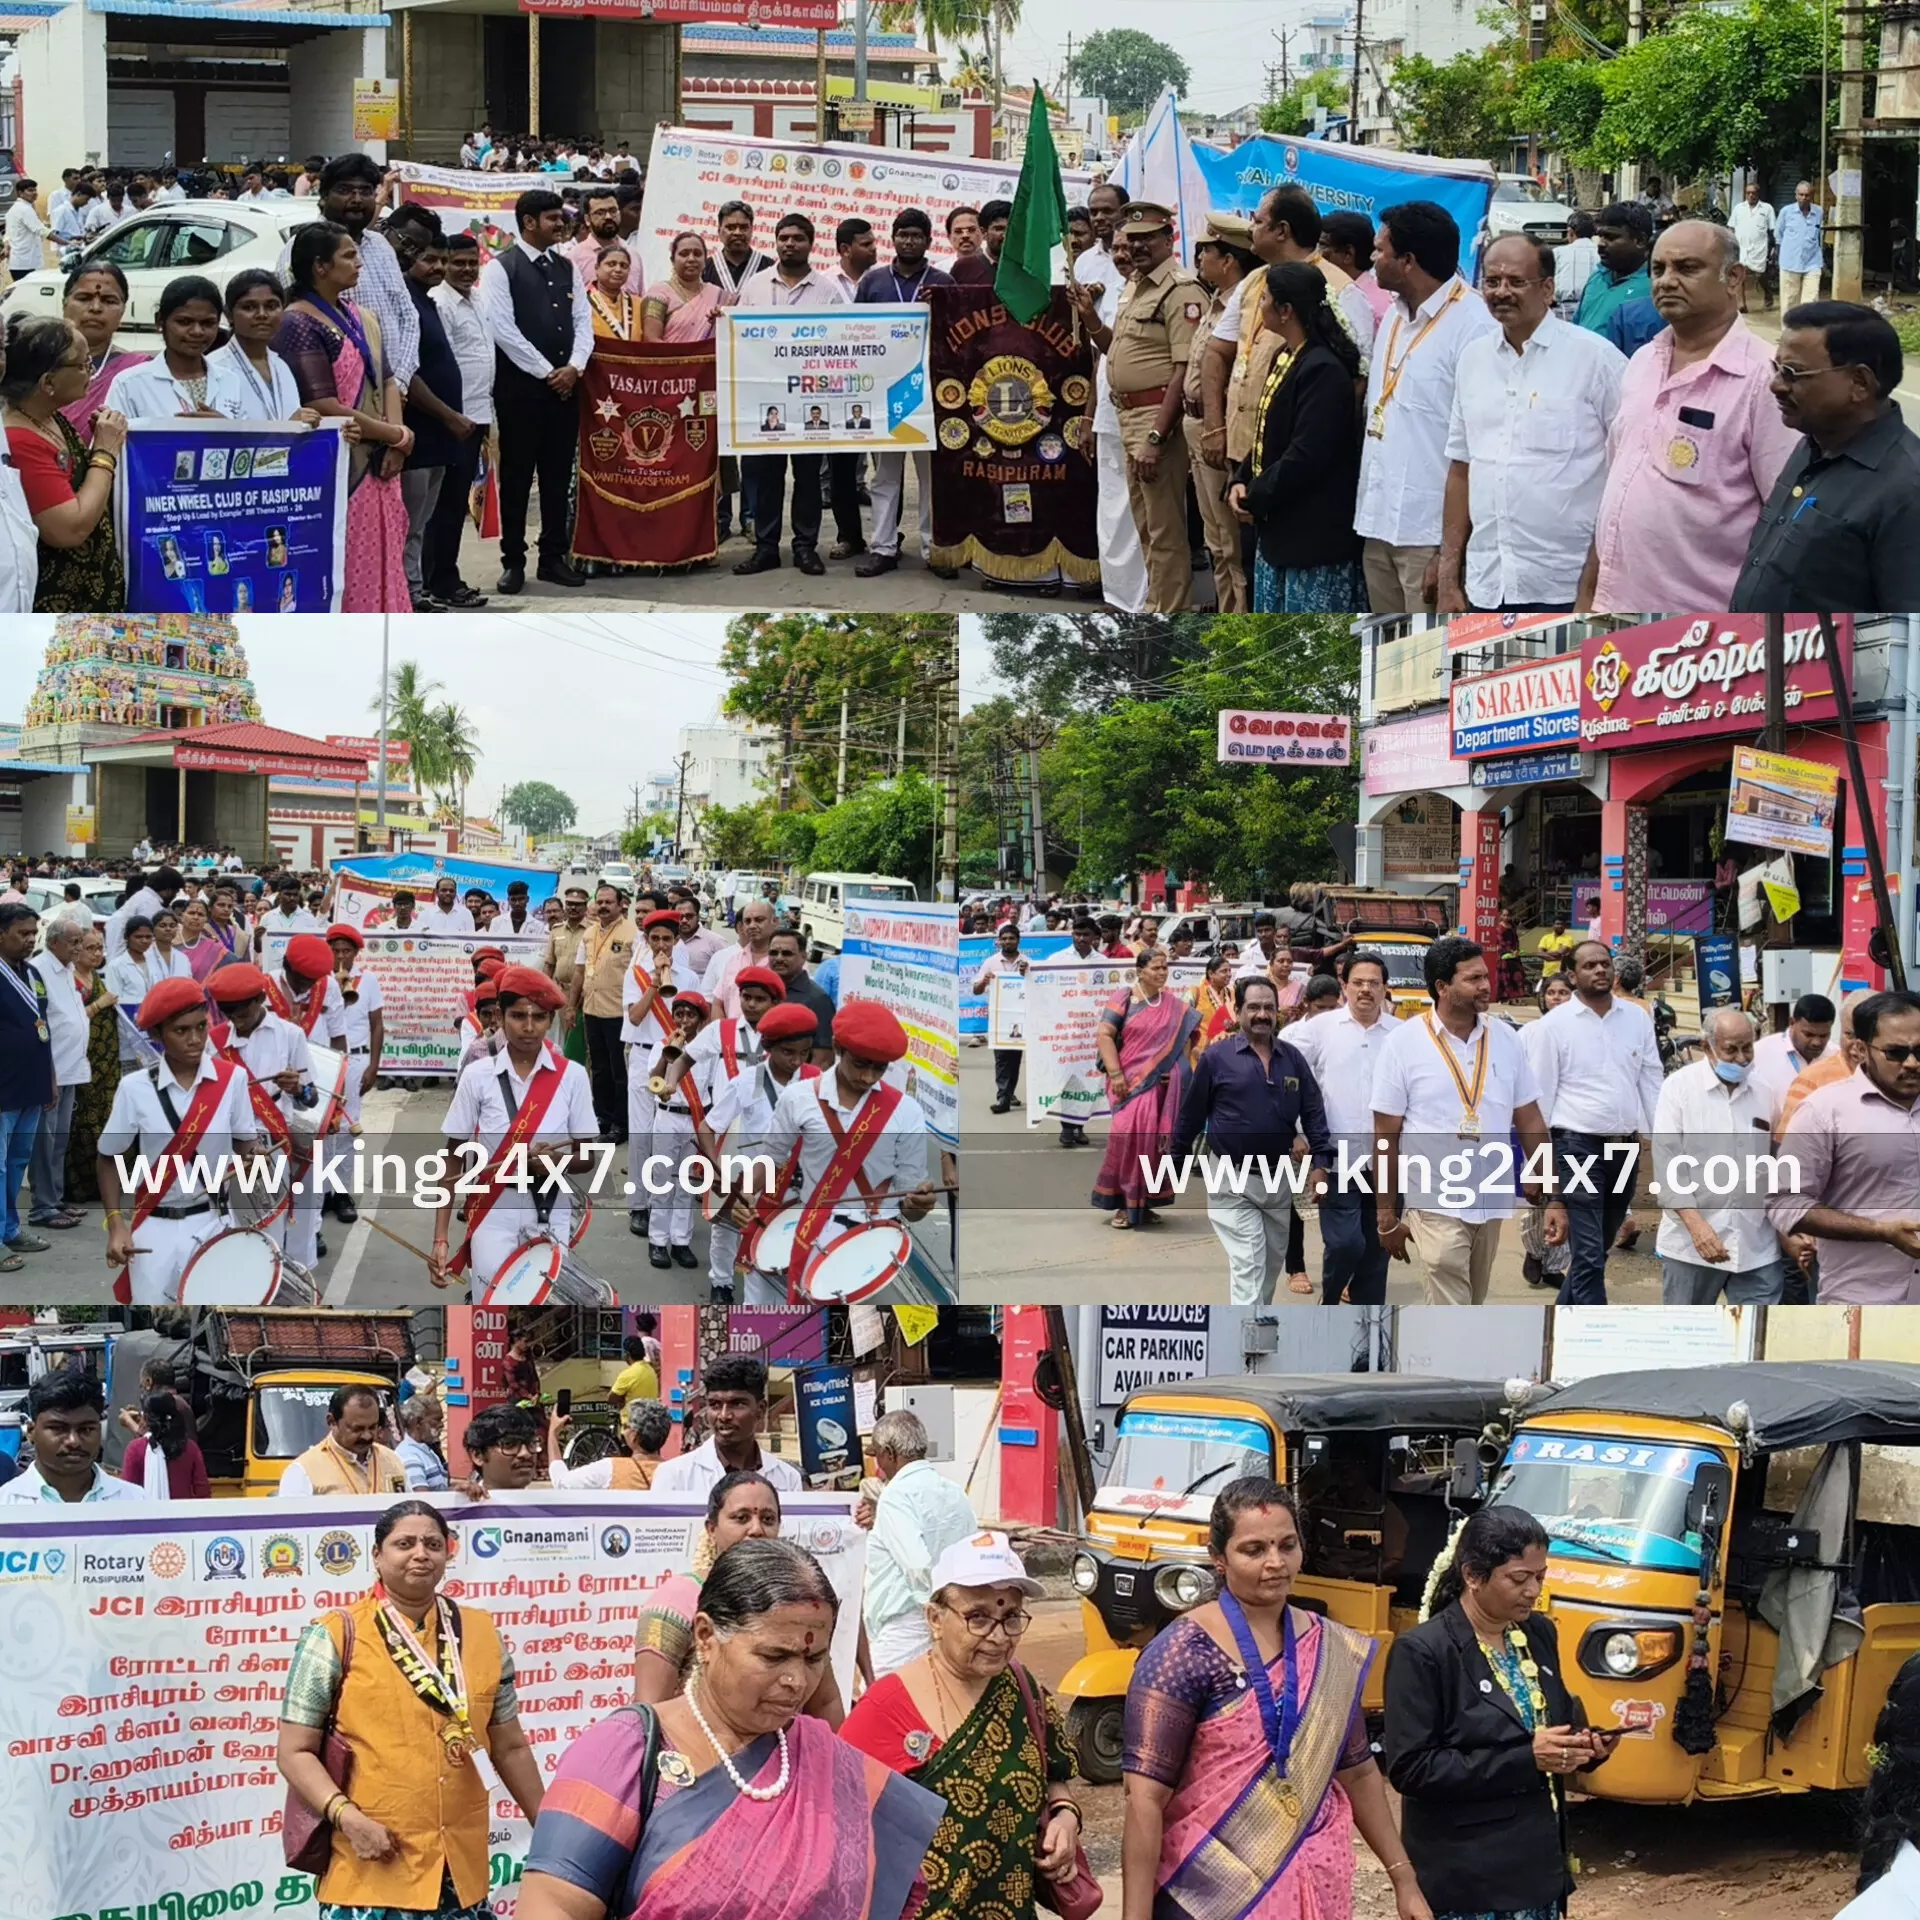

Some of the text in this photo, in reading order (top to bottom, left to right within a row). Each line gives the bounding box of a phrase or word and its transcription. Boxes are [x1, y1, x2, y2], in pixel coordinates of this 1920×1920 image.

[662, 144, 683, 157] JCI
[698, 150, 723, 161] Rotary
[698, 172, 720, 182] JCI
[888, 168, 937, 181] Gnanamani
[741, 327, 765, 338] JCI
[791, 326, 816, 338] JCI
[946, 304, 1006, 351] LIONS
[774, 344, 886, 357] JCI RASIPURAM METRO
[802, 359, 858, 370] JCI WEEK
[988, 360, 1031, 380] LIONS
[608, 373, 697, 396] VASAVI CLUB
[963, 460, 1067, 482] RASIPURAM
[146, 496, 177, 513] INNER
[177, 493, 214, 511] WHEEL
[215, 490, 242, 508] CLUB
[244, 490, 259, 506] OF
[1476, 667, 1579, 720] SARAVANA
[1229, 714, 1347, 739] வேலவன்
[1456, 714, 1579, 751] Department Stores
[1581, 716, 1631, 742] Krishna
[1228, 739, 1347, 761] மெடிக்கல்
[1542, 763, 1566, 777] ATM
[1061, 990, 1077, 998] JCI
[1106, 1305, 1206, 1323] SRV LODGE
[1106, 1337, 1204, 1361] CAR PARKING
[803, 1376, 850, 1394] MilkyMist
[810, 1396, 846, 1407] ICE CREAM
[1534, 1441, 1657, 1467] RASI
[503, 1526, 589, 1545] Gnanamani
[84, 1553, 145, 1572] Rotary
[83, 1574, 145, 1584] RASIPURAM
[1118, 1579, 1131, 1592] RE
[89, 1596, 144, 1616] JCI
[153, 1587, 306, 1618] இராசிபுரம்
[443, 1573, 571, 1599] இராசிபுரம்
[492, 1601, 592, 1627] ராசிபுரம்
[110, 1653, 230, 1678] ரோட்டரி
[57, 1682, 206, 1717] இராசிபுரம்
[7, 1725, 107, 1758] வாசவி
[114, 1711, 180, 1744] கிளப்
[69, 1766, 278, 1819] முத்தாயம்மாள்
[168, 1820, 252, 1850] வித்யா
